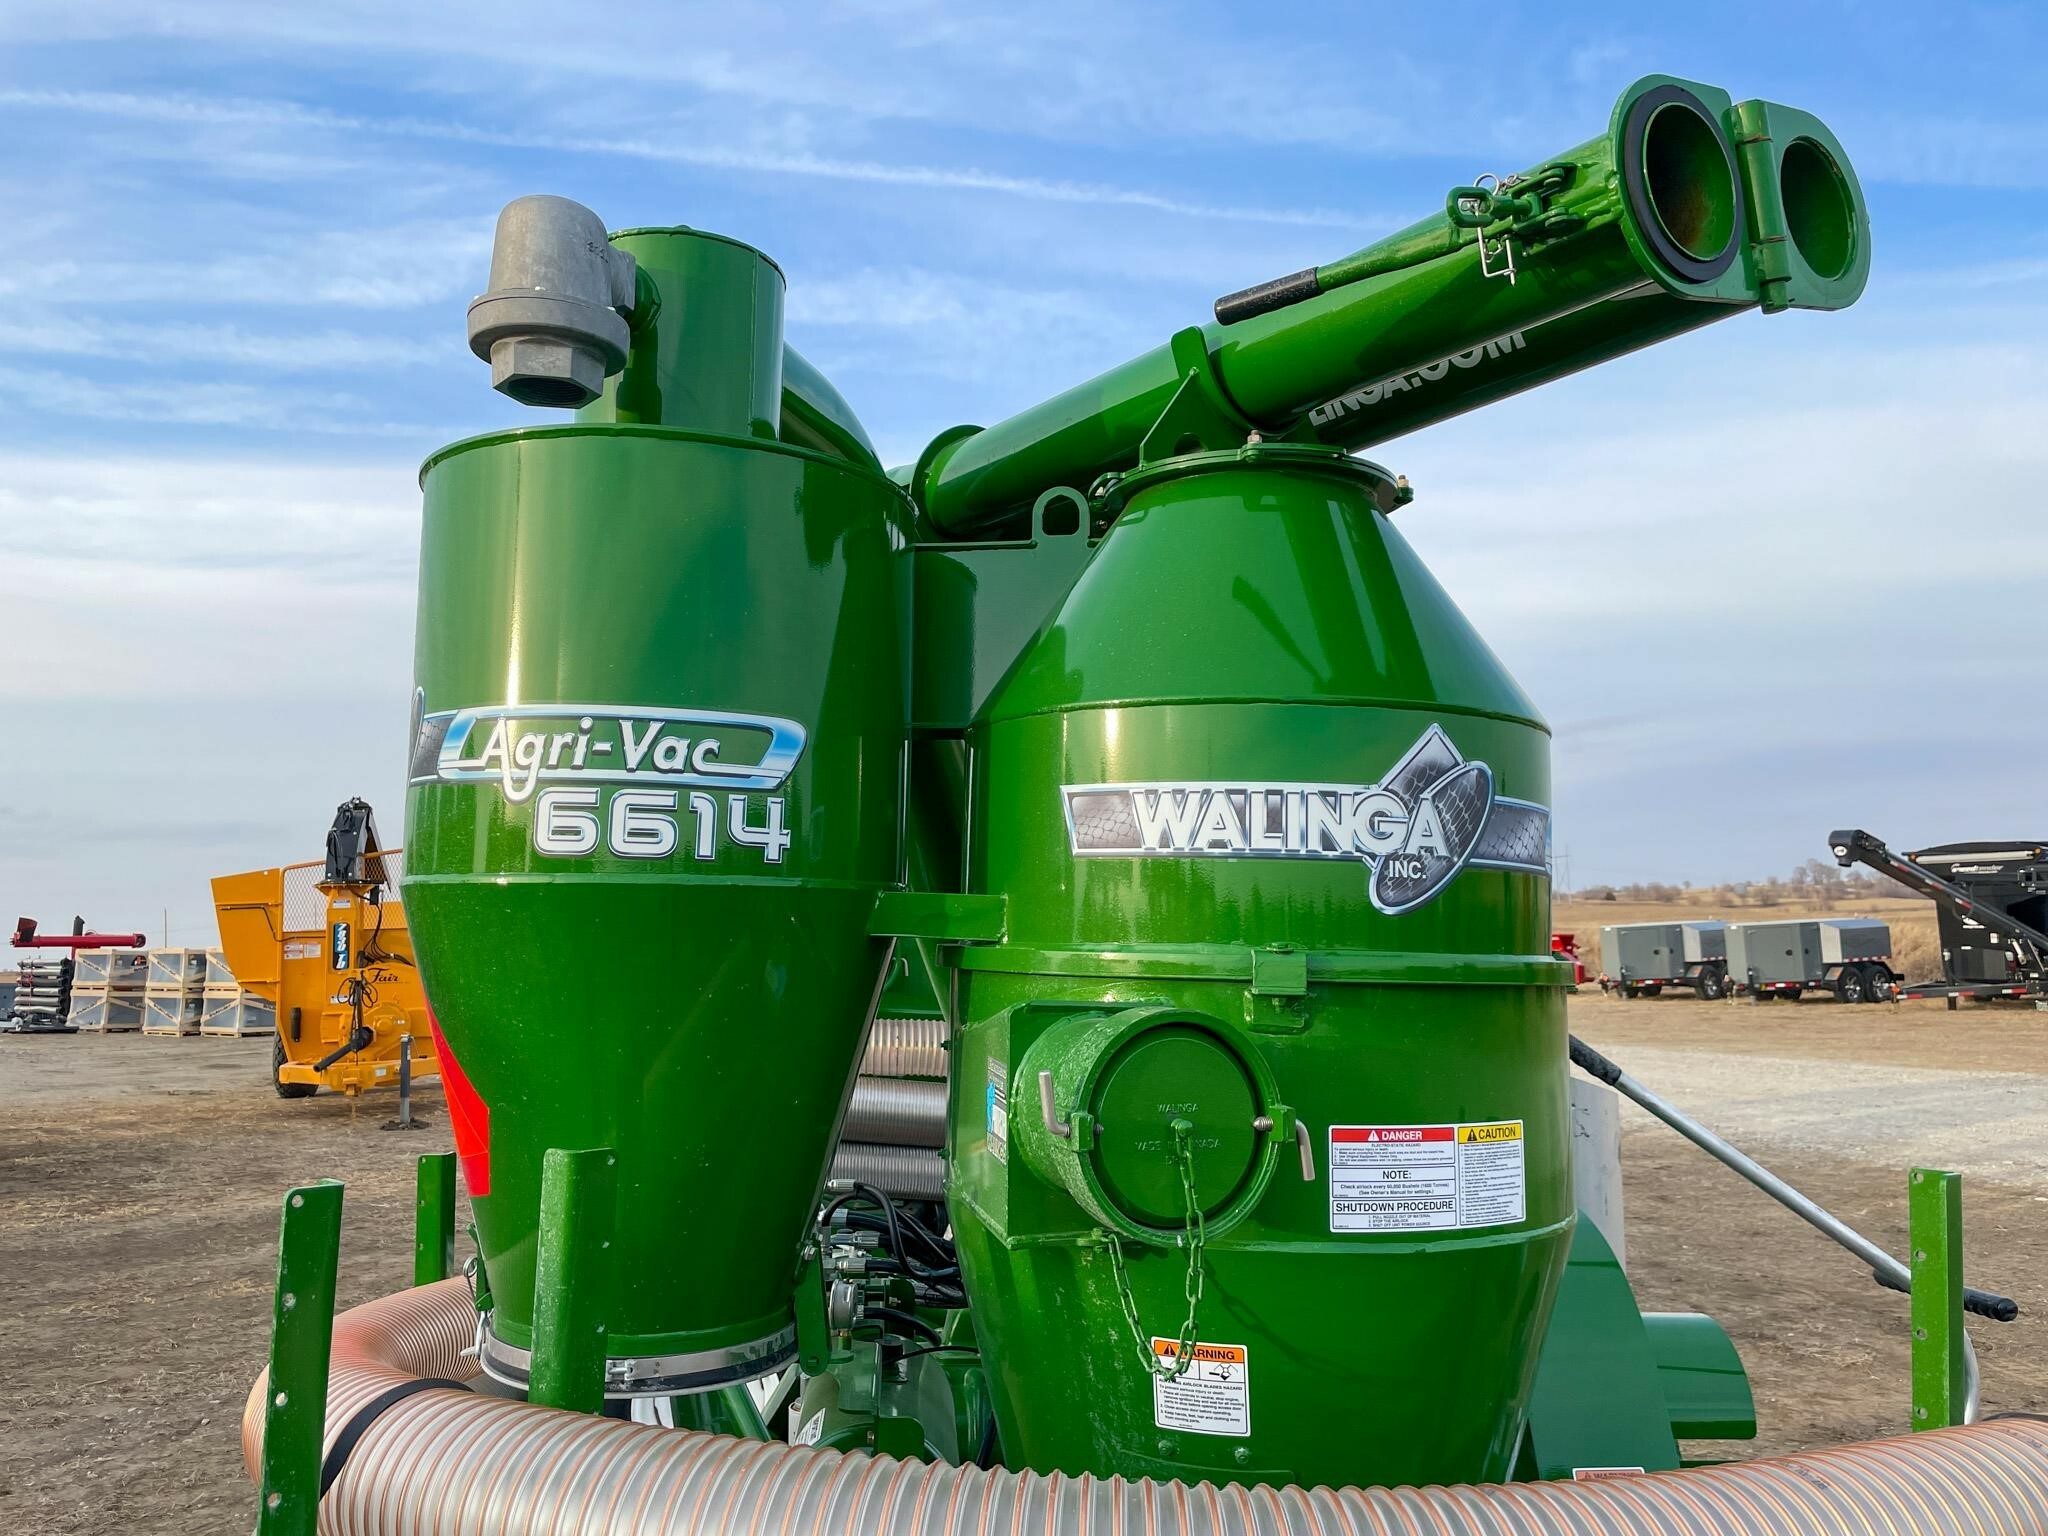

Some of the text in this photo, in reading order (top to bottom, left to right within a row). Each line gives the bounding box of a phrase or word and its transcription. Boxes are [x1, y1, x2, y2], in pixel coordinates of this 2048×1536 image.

[479, 715, 721, 803] Agri-Vac
[534, 786, 791, 864] 6614
[1131, 787, 1451, 857] WALINGA
[1388, 859, 1427, 880] INC.
[368, 967, 399, 983] Fair
[1382, 1131, 1422, 1140] DANGER
[1478, 1127, 1516, 1140] CAUTION
[1383, 1170, 1412, 1180] NOTE:
[1336, 1200, 1454, 1213] SHUTDOWN PROCEDURE
